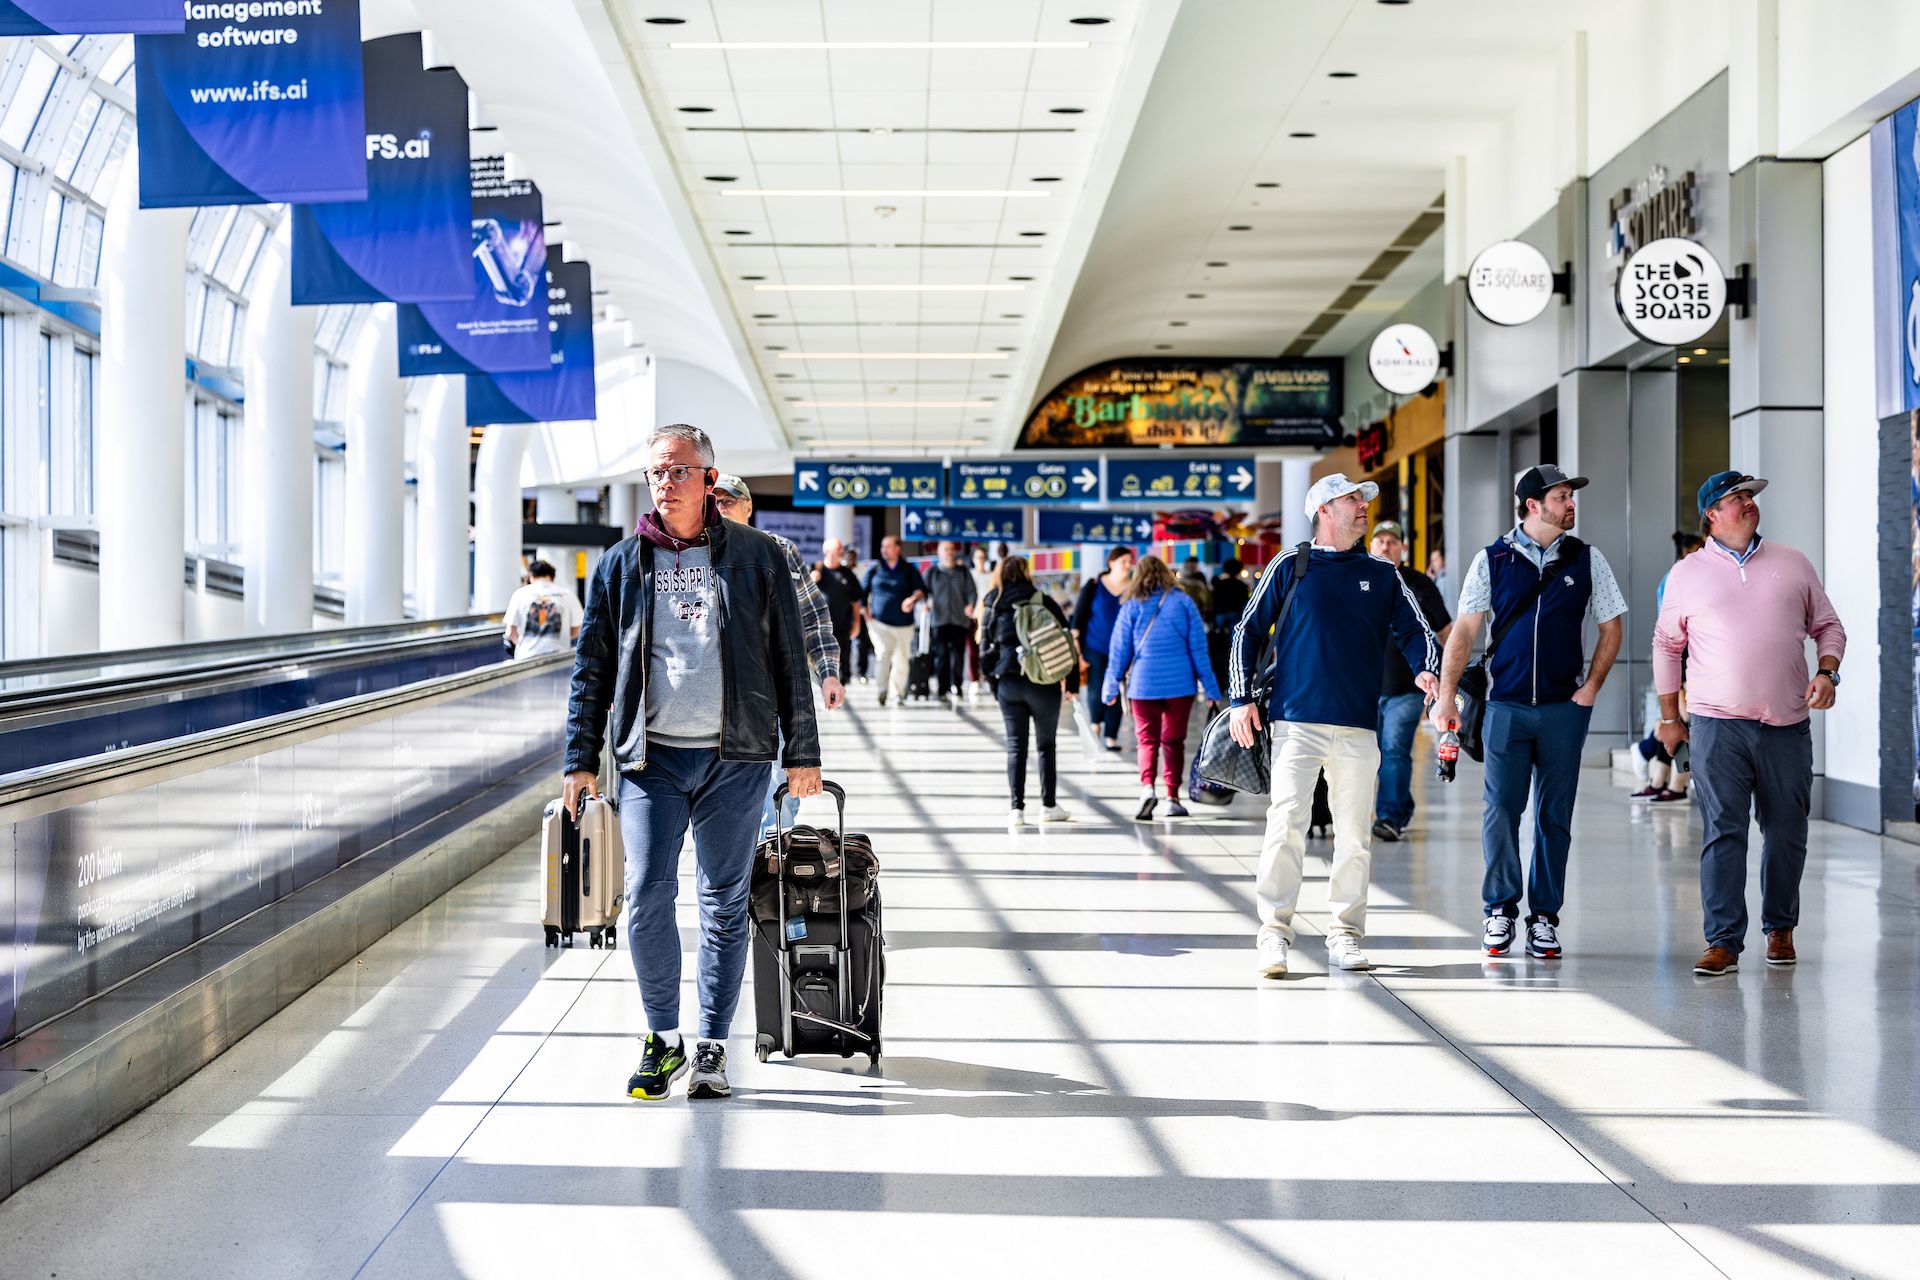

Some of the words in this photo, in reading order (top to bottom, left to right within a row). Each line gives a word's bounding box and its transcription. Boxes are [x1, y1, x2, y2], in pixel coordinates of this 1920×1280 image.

[184, 0, 323, 23] anagement
[196, 25, 298, 48] software
[190, 78, 308, 104] www.ifs.ai
[1629, 172, 1695, 252] SQUARE
[1634, 264, 1671, 281] THE
[1495, 273, 1546, 291] SQUARE
[1635, 283, 1709, 300] SCORE
[1635, 303, 1712, 320] BOARD
[419, 344, 442, 355] IFS.ai
[1066, 388, 1228, 428] Barbados
[1181, 423, 1193, 438] is
[827, 464, 892, 476] Gates/Atrium
[959, 464, 998, 475] Elevator
[1000, 464, 1012, 475] to
[1037, 463, 1066, 475] Gates
[1188, 462, 1208, 474] Exit
[1210, 462, 1222, 474] to
[77, 852, 96, 888] 200
[97, 844, 122, 880] billion
[77, 894, 105, 926] packages
[77, 929, 86, 956] by
[85, 924, 96, 949] the
[96, 918, 116, 944] world's
[115, 909, 136, 933] leading
[170, 888, 183, 909] using
